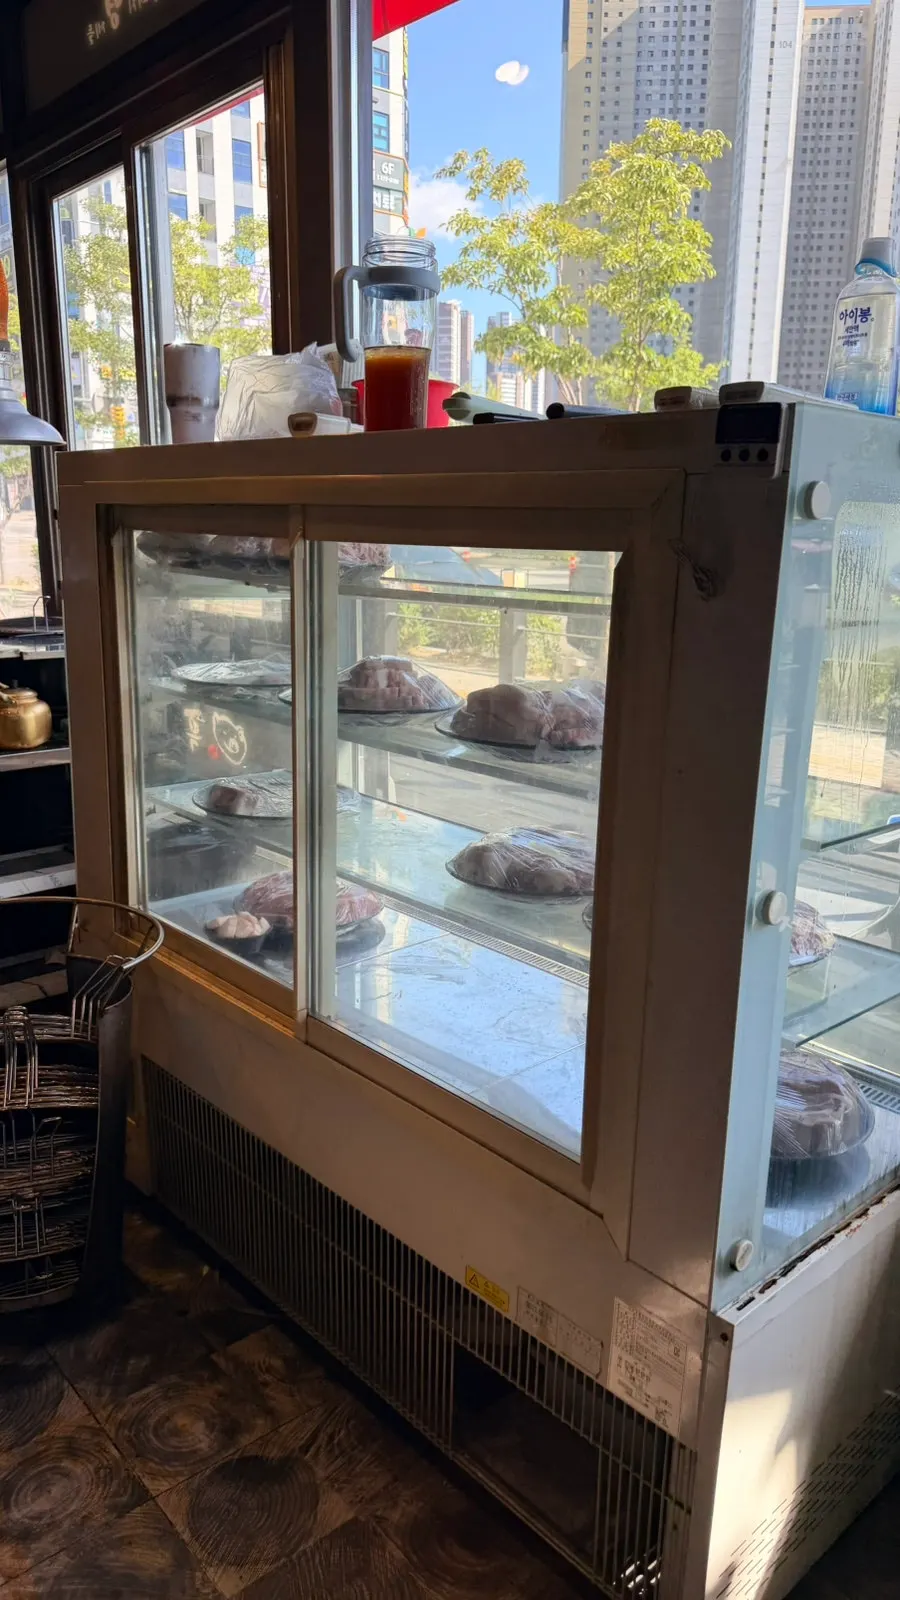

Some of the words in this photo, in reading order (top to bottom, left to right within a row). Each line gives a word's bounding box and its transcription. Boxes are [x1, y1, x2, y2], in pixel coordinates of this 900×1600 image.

[779, 40, 793, 49] 104
[381, 162, 395, 175] 6F
[839, 306, 872, 325] 아이봉
